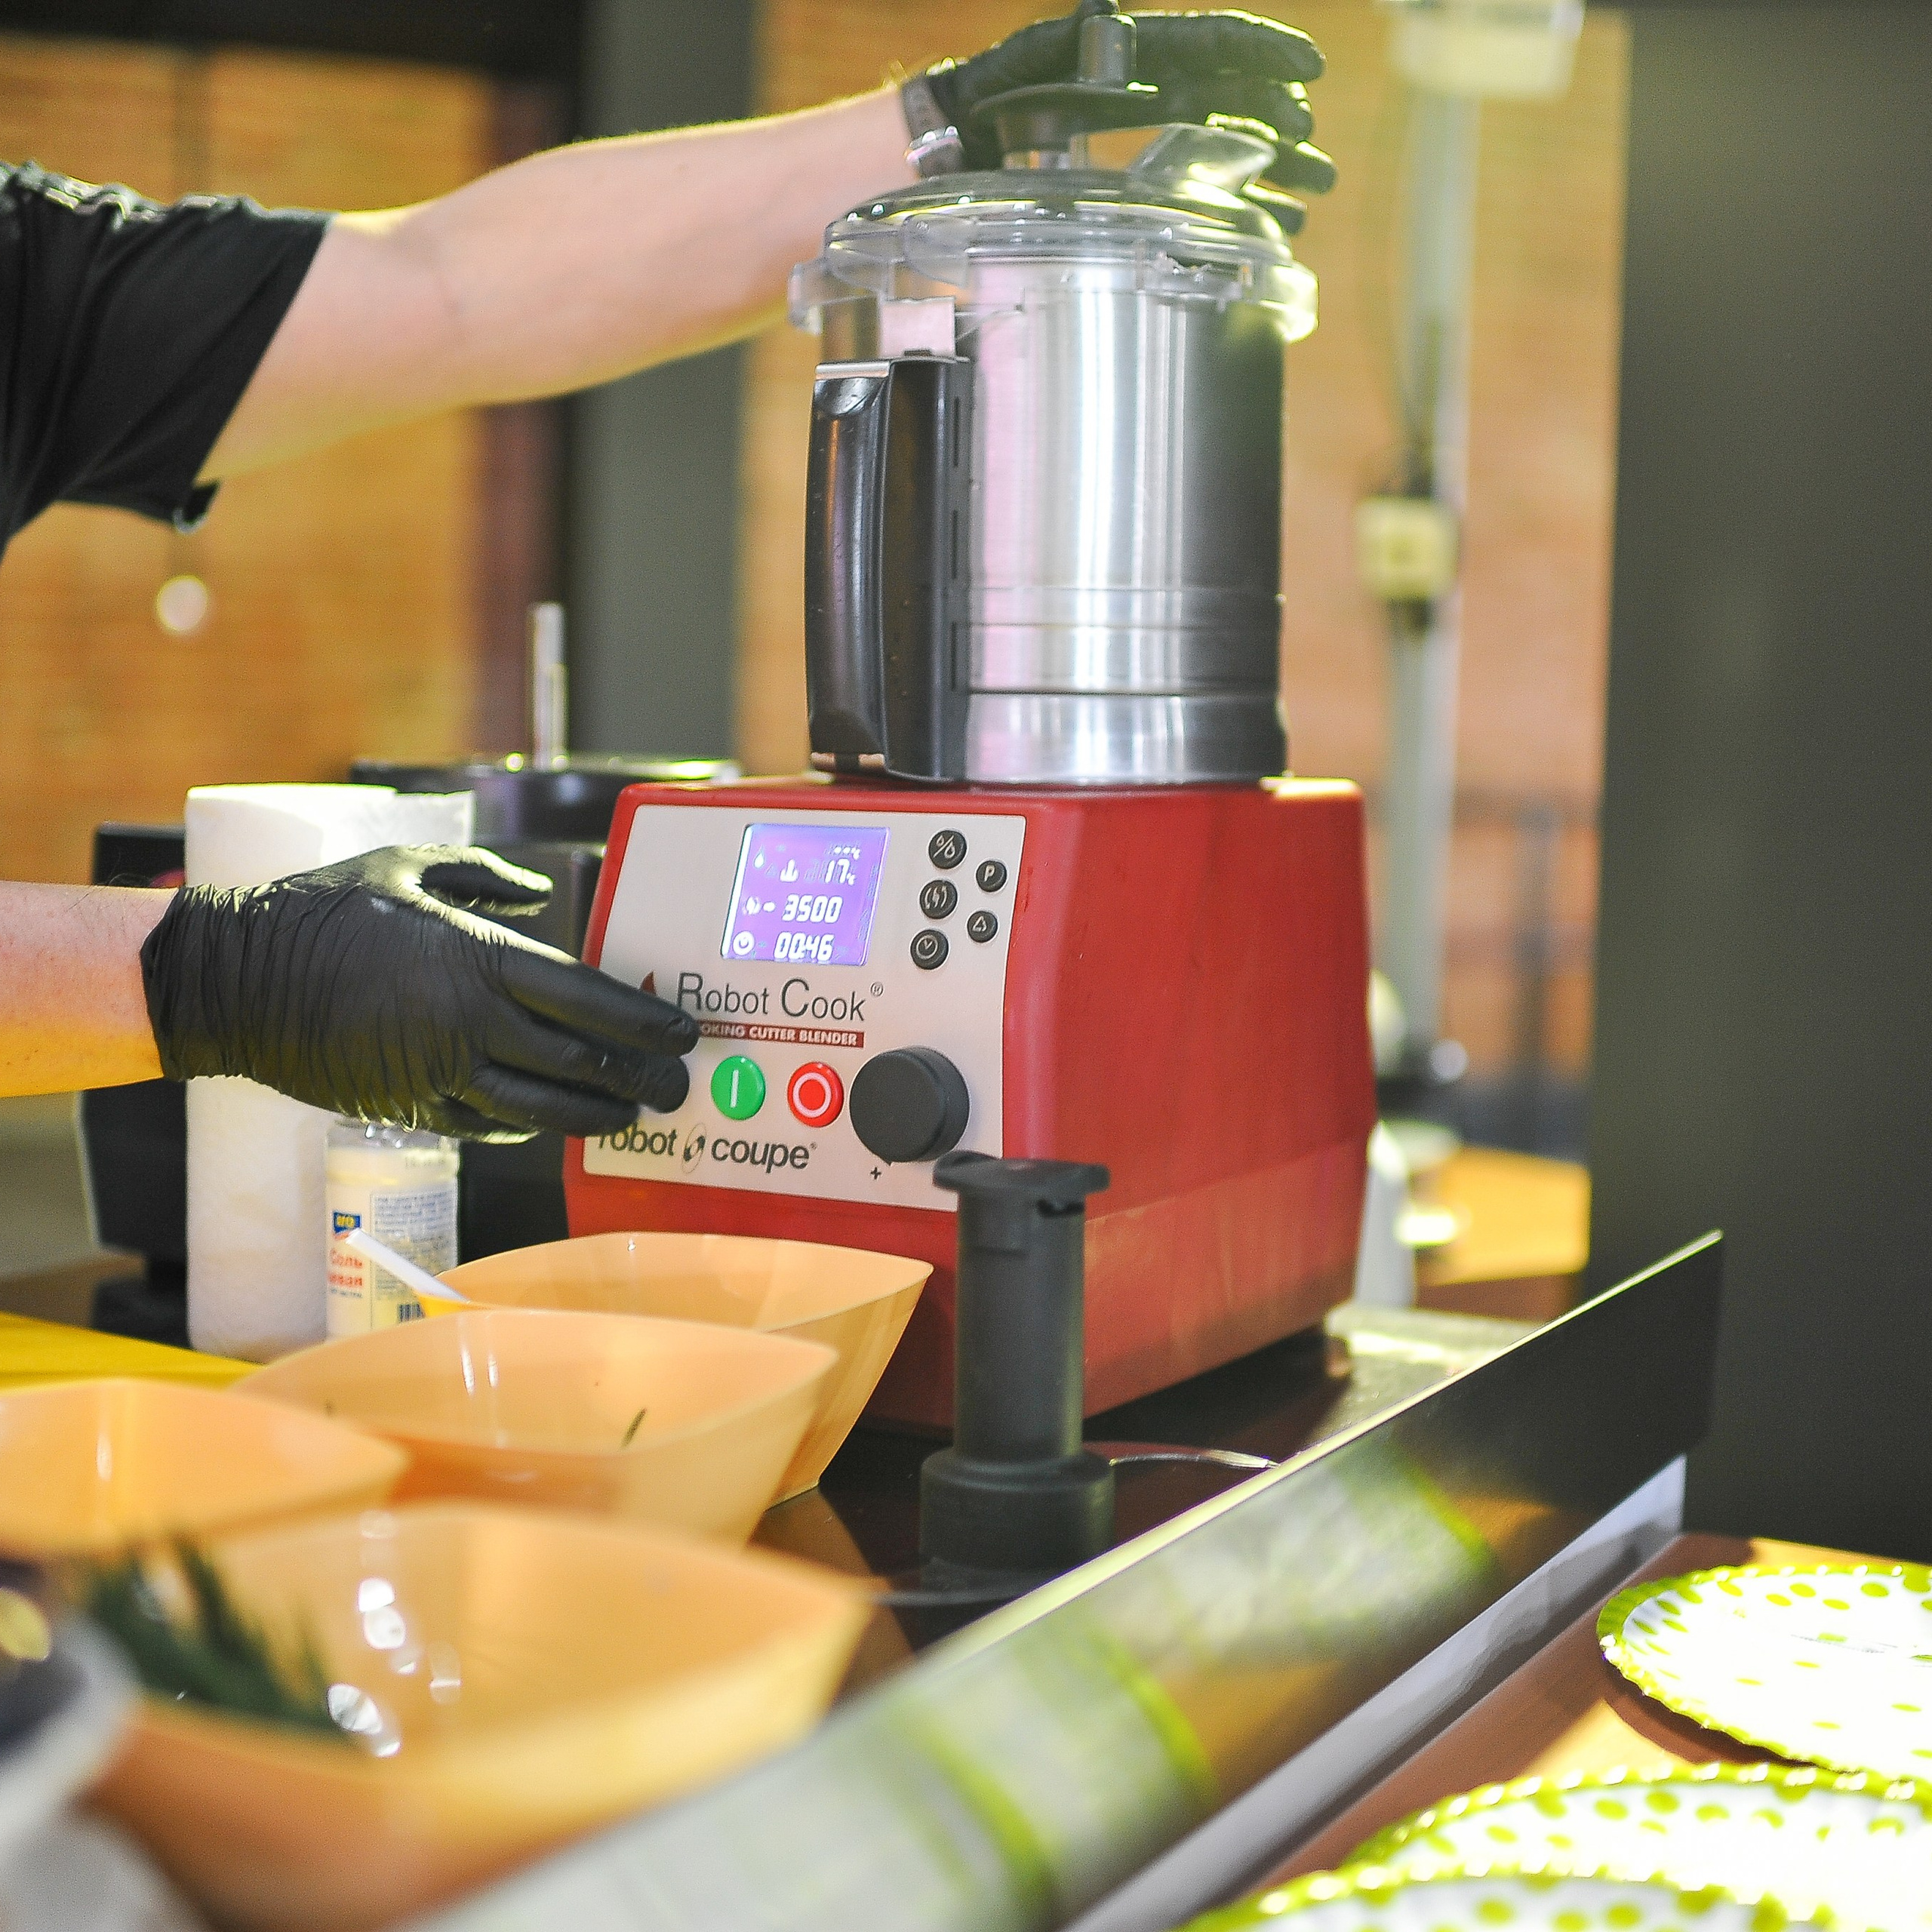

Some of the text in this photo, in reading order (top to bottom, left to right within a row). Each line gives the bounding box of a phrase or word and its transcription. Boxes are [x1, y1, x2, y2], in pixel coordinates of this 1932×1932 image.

[983, 864, 995, 882] P
[782, 894, 843, 924] 3500
[678, 972, 770, 1015] Robot
[700, 1023, 858, 1046] OKING CUTTER BLENDER
[598, 1121, 811, 1174] robot coupe
